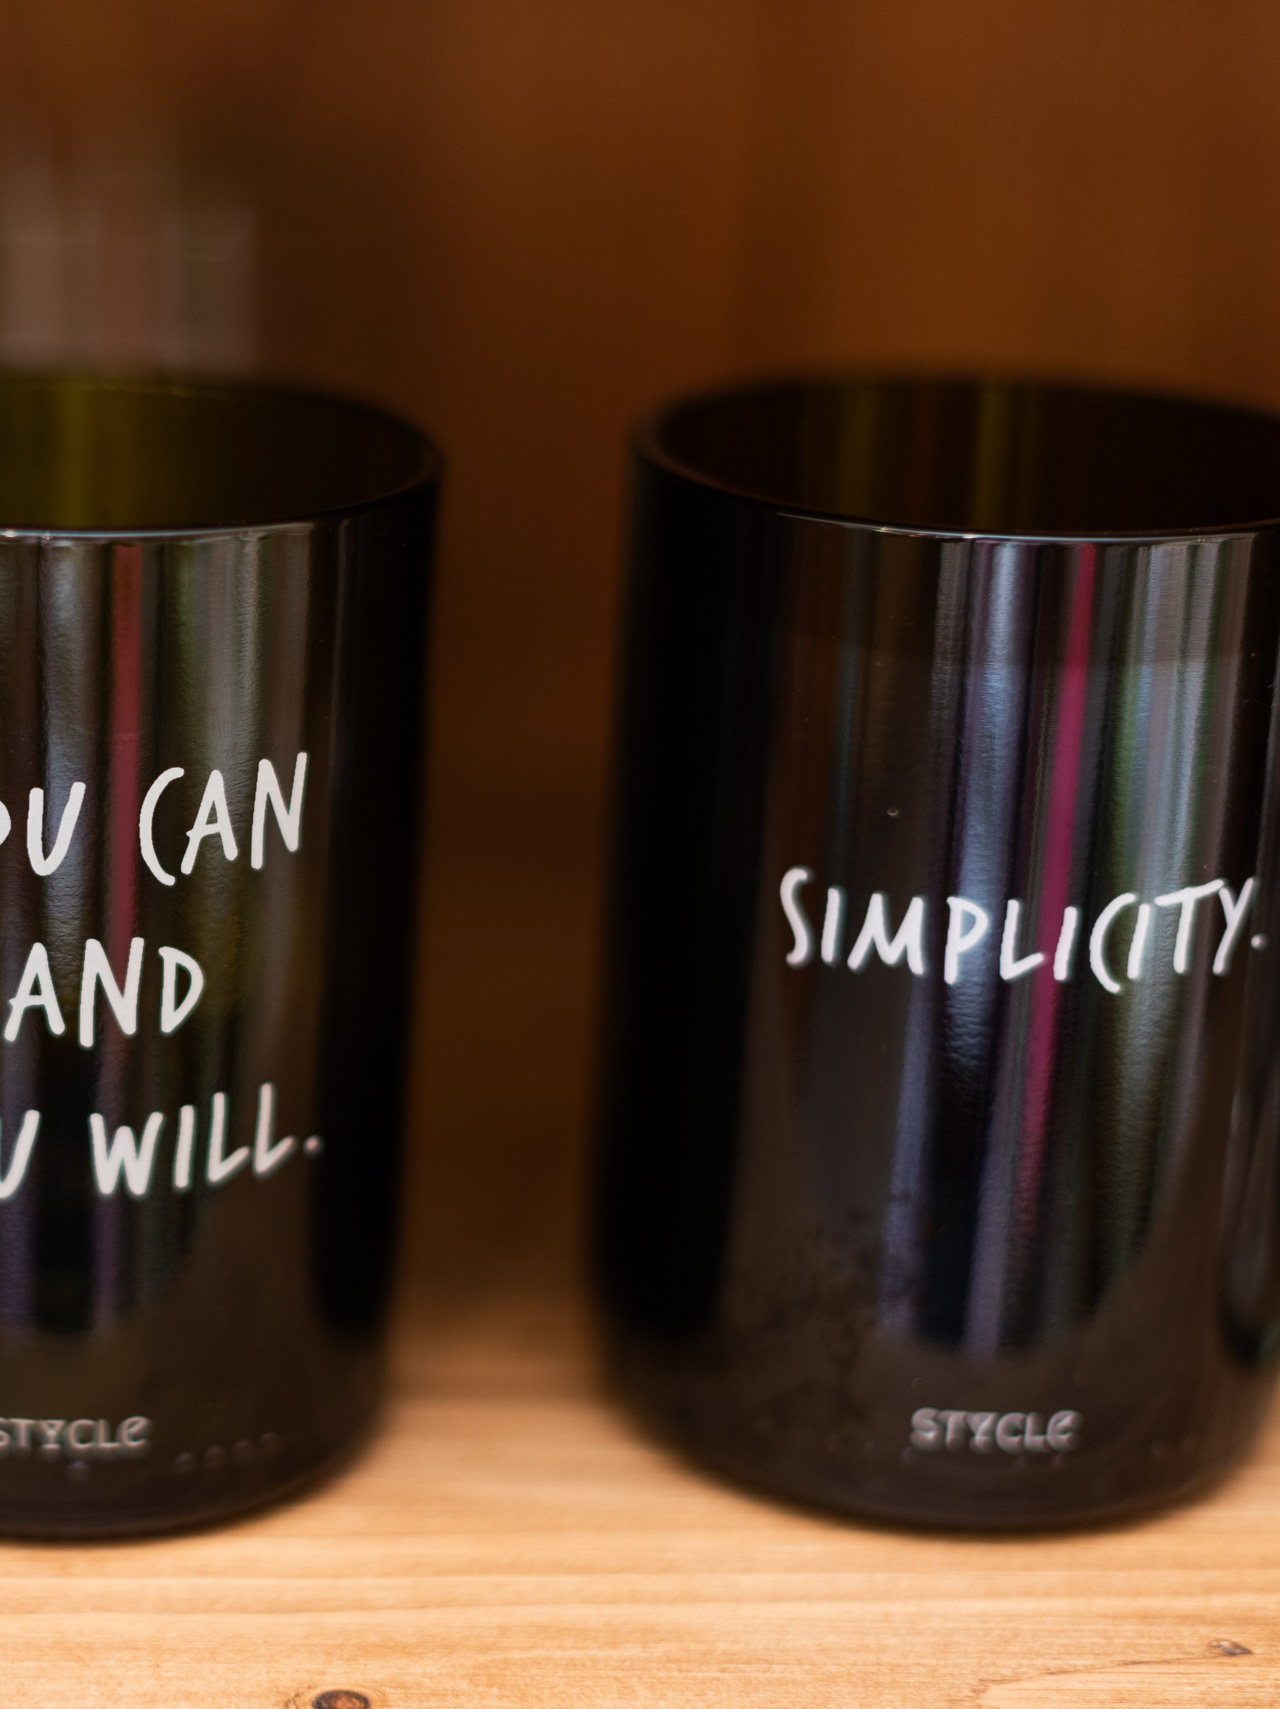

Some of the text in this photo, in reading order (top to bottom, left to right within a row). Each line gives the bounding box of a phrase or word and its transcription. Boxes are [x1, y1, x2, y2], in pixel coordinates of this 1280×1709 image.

[138, 752, 307, 886] CAN
[779, 865, 1268, 994] SIMPLICITY.
[4, 936, 204, 1048] AND
[88, 1081, 324, 1197] WILL.
